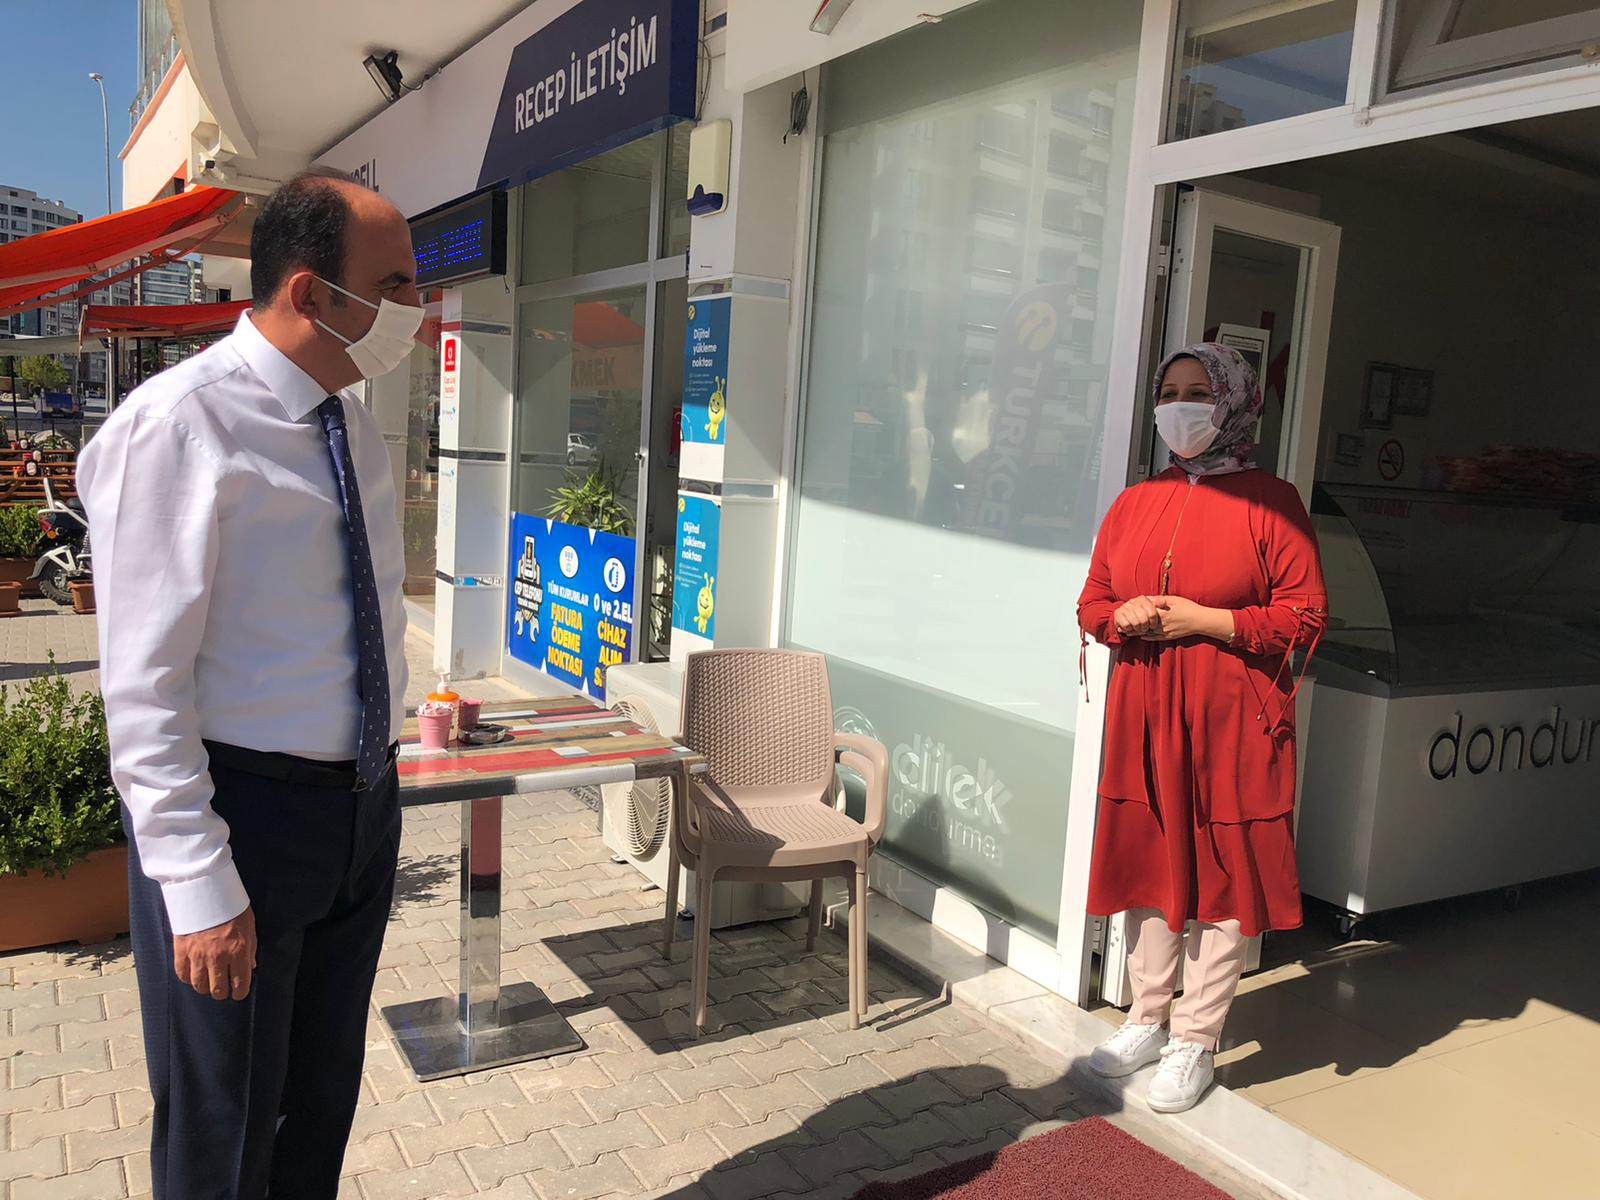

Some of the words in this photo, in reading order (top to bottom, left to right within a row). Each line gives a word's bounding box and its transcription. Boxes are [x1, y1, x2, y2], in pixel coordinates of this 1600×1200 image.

[515, 68, 566, 134] RECEP
[570, 15, 657, 105] İLETİŞİM
[547, 579, 559, 596] TÜM
[550, 602, 583, 631] FATURA
[601, 599, 612, 617] ve
[551, 620, 581, 654] ÖDEME
[597, 617, 626, 649] CİHAZ
[547, 645, 583, 678] NOKTASI
[599, 645, 623, 667] ALIM
